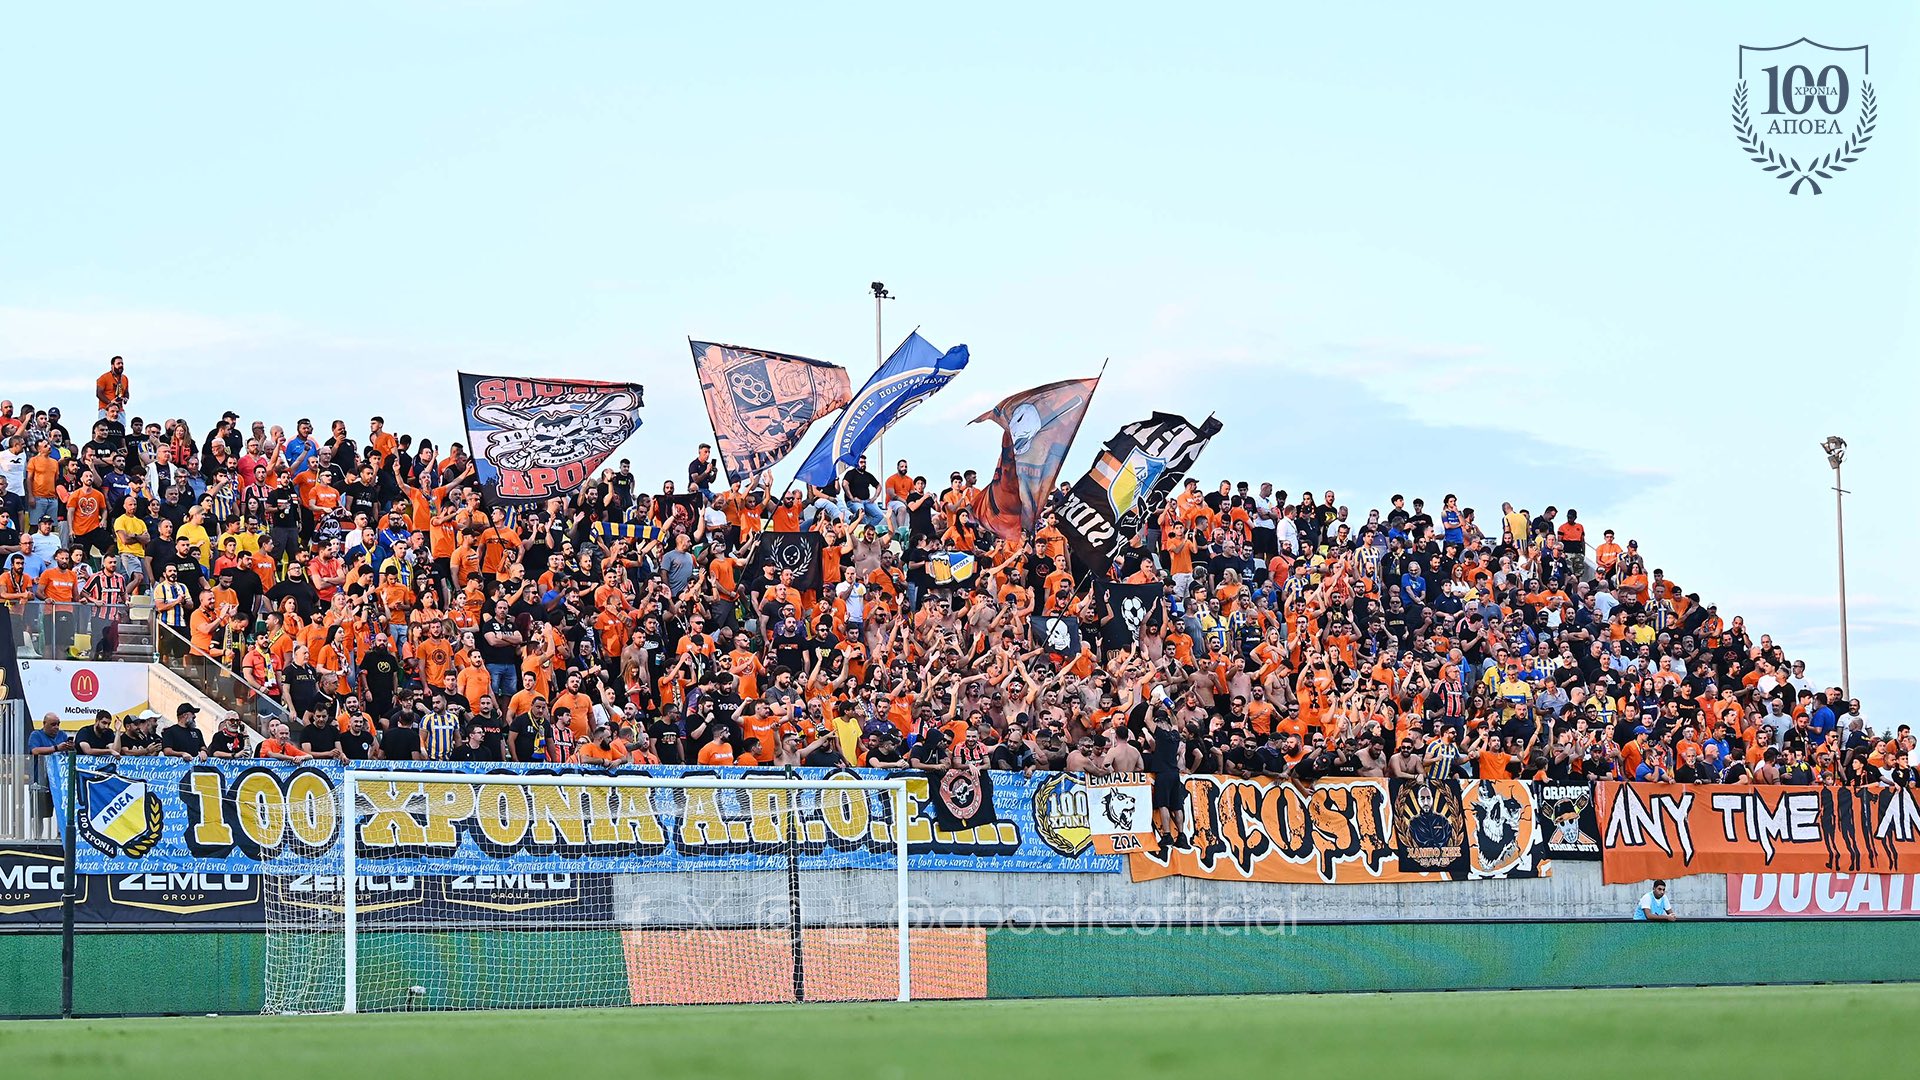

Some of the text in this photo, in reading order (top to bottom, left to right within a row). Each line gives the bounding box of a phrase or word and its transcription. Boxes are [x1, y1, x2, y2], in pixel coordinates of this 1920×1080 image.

[101, 792, 134, 824] ΑΠΟΕΛ
[191, 771, 337, 848] 100
[355, 773, 666, 846] ΧΡΟΝΙΑ
[681, 769, 1019, 846] Α.Π.Ο.Ε..
[1048, 791, 1089, 817] 100
[1184, 776, 1389, 881] ICOSI
[1604, 782, 1696, 867] ANY
[1711, 788, 1823, 866] TIME
[1110, 835, 1142, 850] ΖΩΑ
[0, 865, 78, 890] MCO
[119, 874, 250, 891] ZEMCO
[452, 873, 571, 890] ZEMCO
